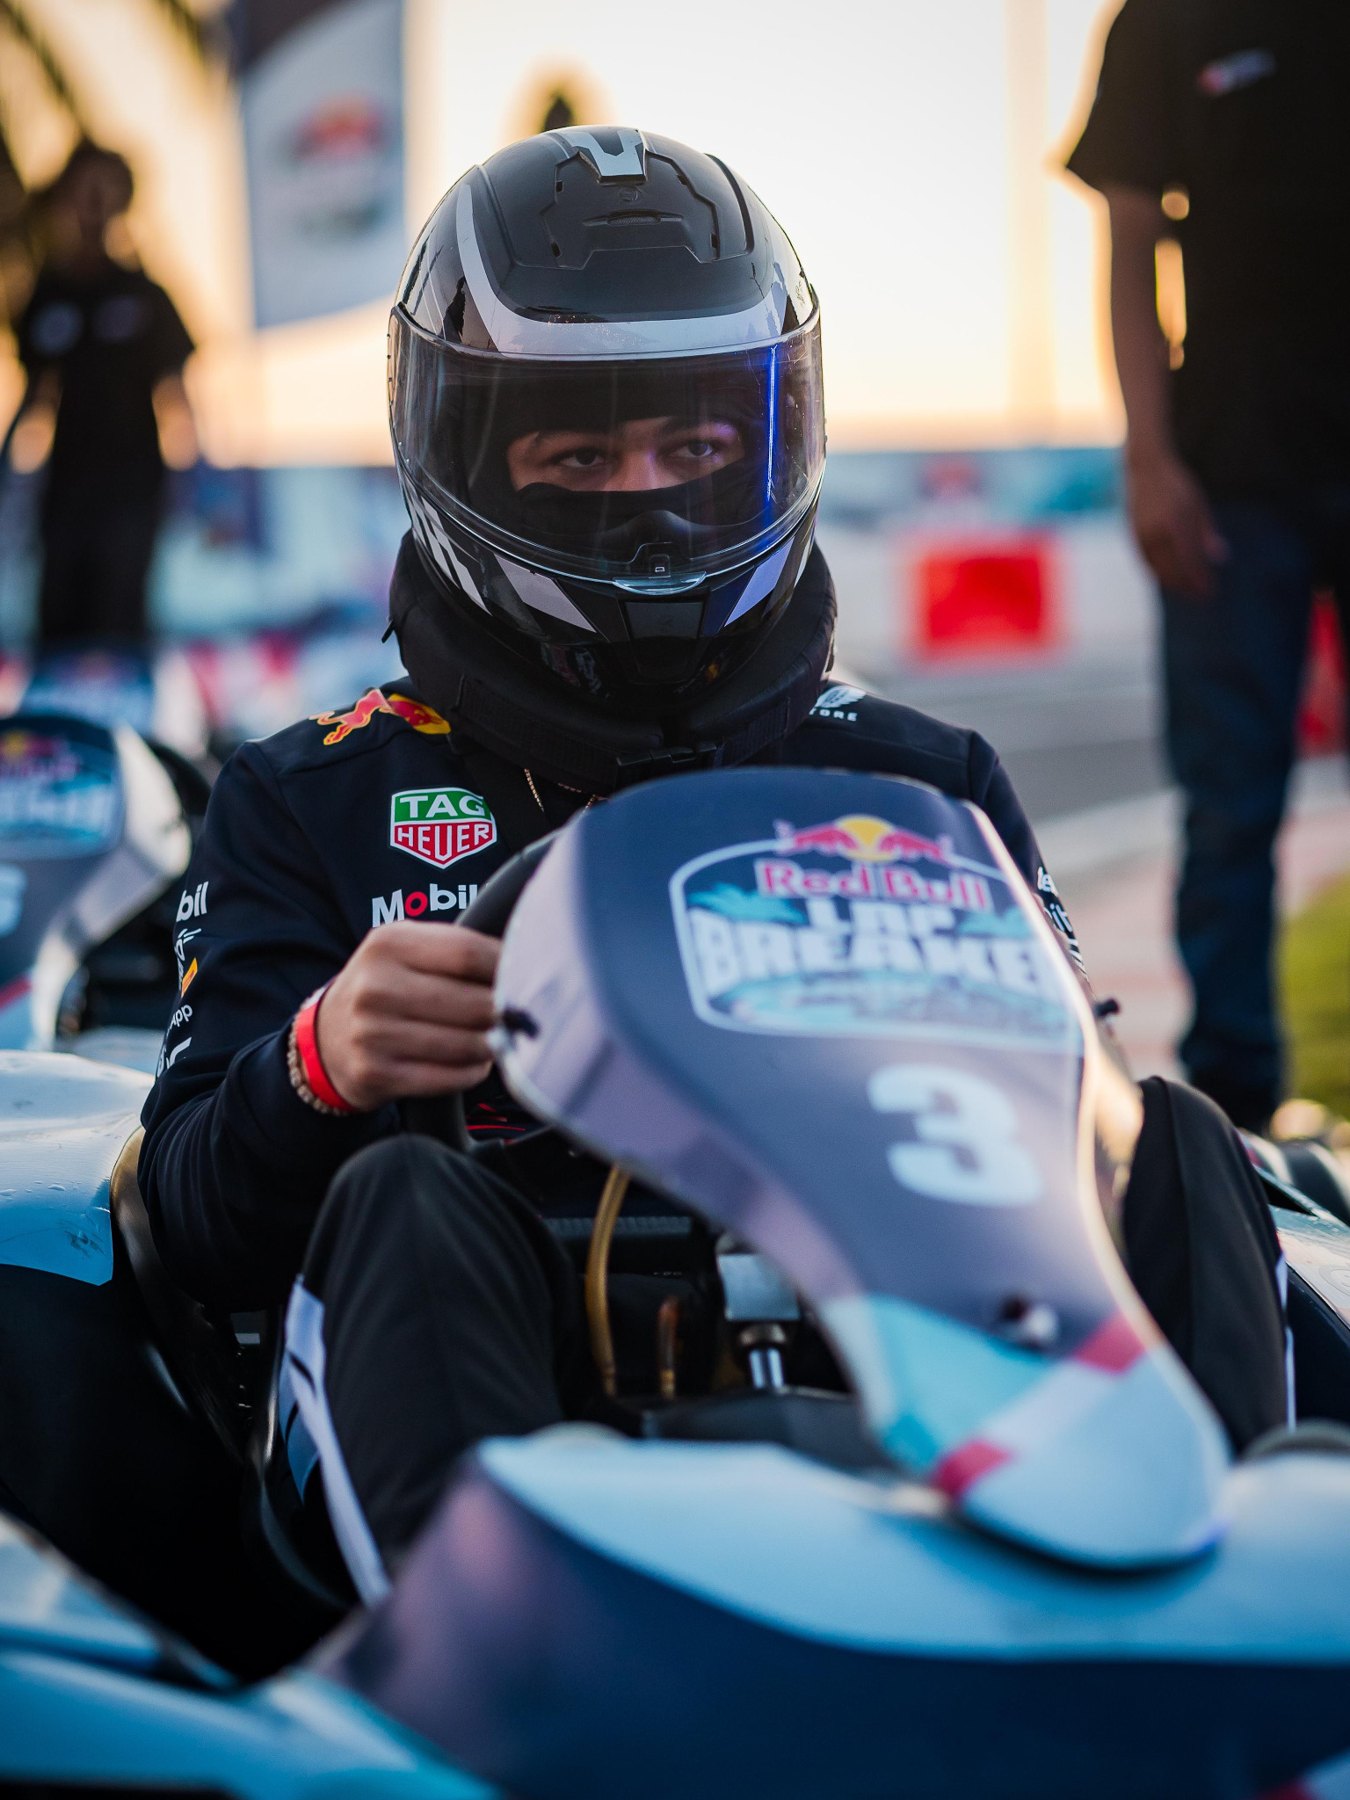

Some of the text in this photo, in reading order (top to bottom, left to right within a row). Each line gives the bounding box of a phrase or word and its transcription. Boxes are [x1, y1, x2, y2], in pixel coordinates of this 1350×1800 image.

[399, 794, 486, 819] TAG
[397, 823, 490, 862] HEUER
[371, 883, 478, 929] Mobil
[754, 858, 873, 901] Red
[883, 867, 994, 912] Bull
[806, 898, 954, 944] LAP
[868, 1064, 1043, 1207] 3
